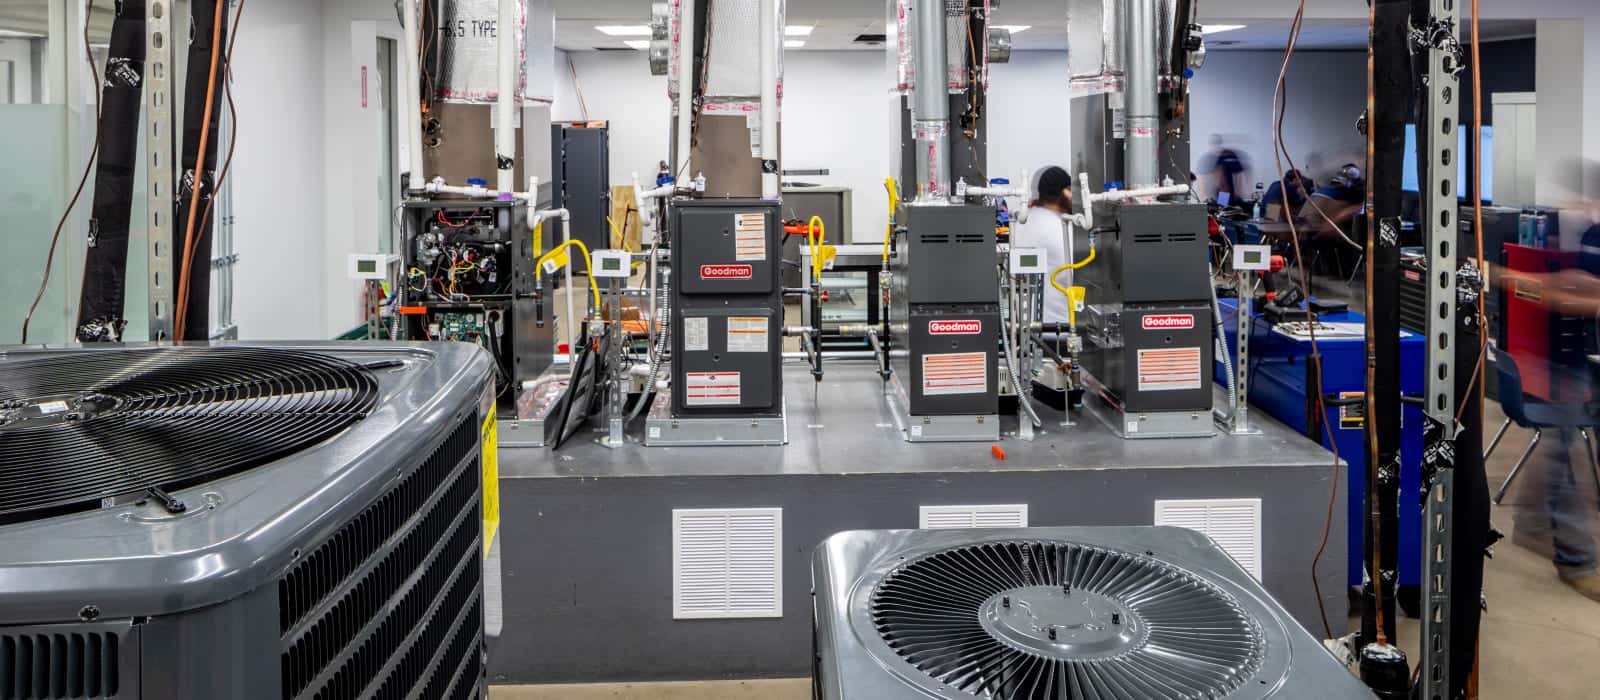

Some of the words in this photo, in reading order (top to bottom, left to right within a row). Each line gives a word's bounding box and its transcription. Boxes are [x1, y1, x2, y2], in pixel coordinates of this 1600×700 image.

[471, 20, 497, 38] TYPE
[704, 267, 749, 275] Goodman
[1144, 317, 1192, 326] Goodman
[931, 322, 979, 331] Goodman
